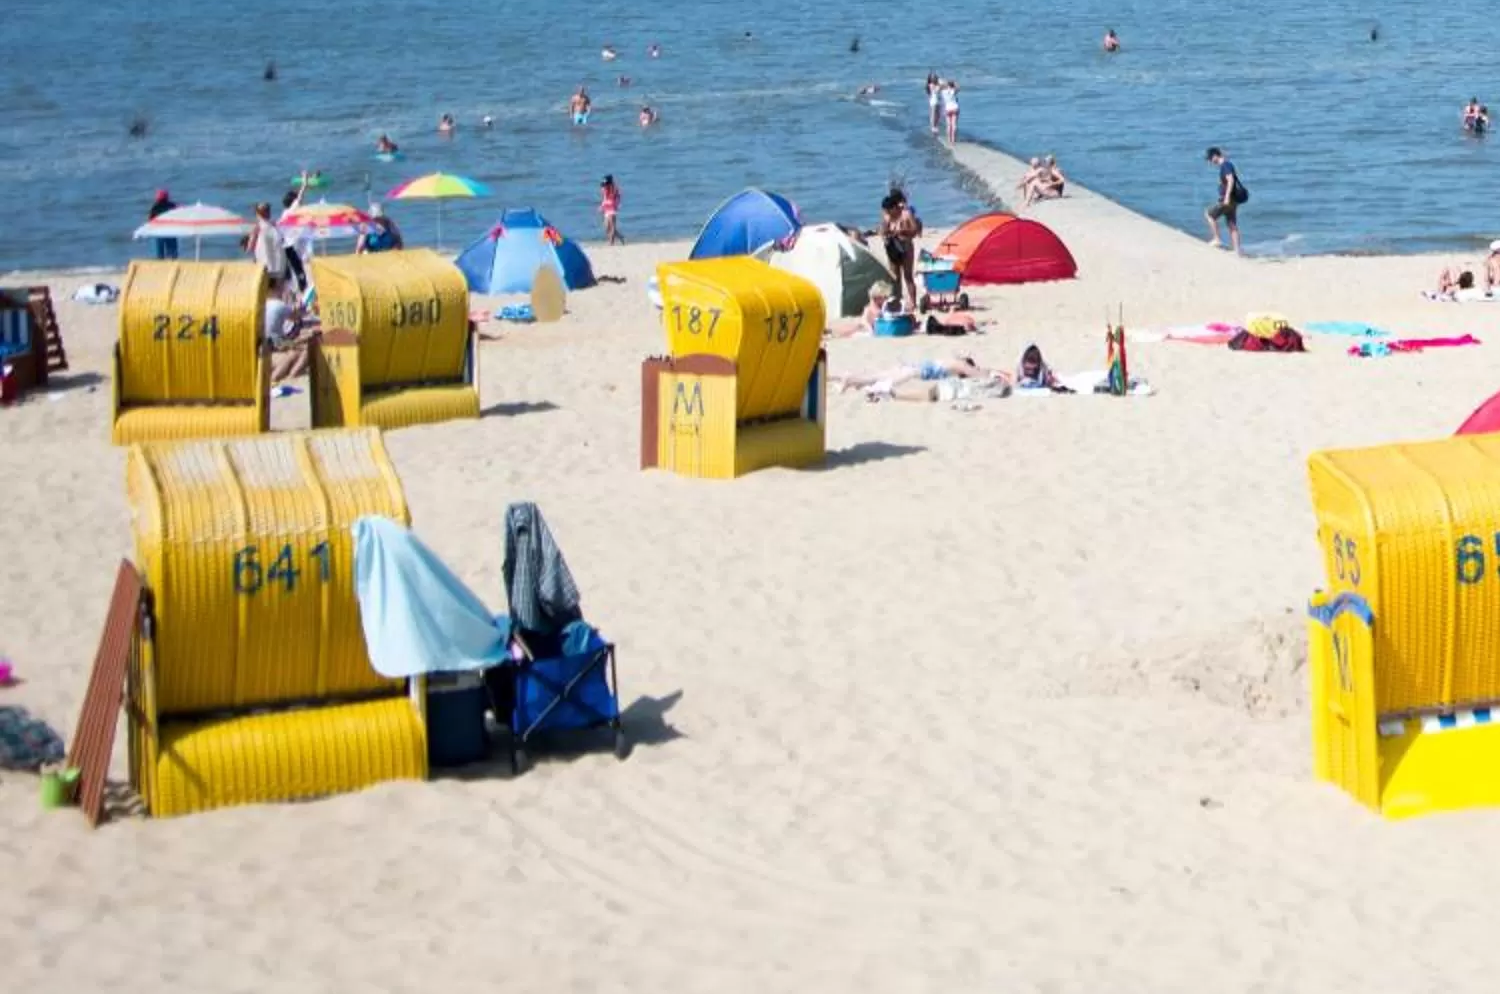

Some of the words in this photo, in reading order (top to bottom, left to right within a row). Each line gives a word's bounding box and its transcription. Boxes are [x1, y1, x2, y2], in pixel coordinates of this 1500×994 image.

[153, 314, 221, 341] 224
[672, 305, 723, 338] 187
[765, 311, 805, 342] 187
[673, 381, 705, 417] M
[232, 540, 330, 594] 641
[1332, 532, 1362, 586] 65
